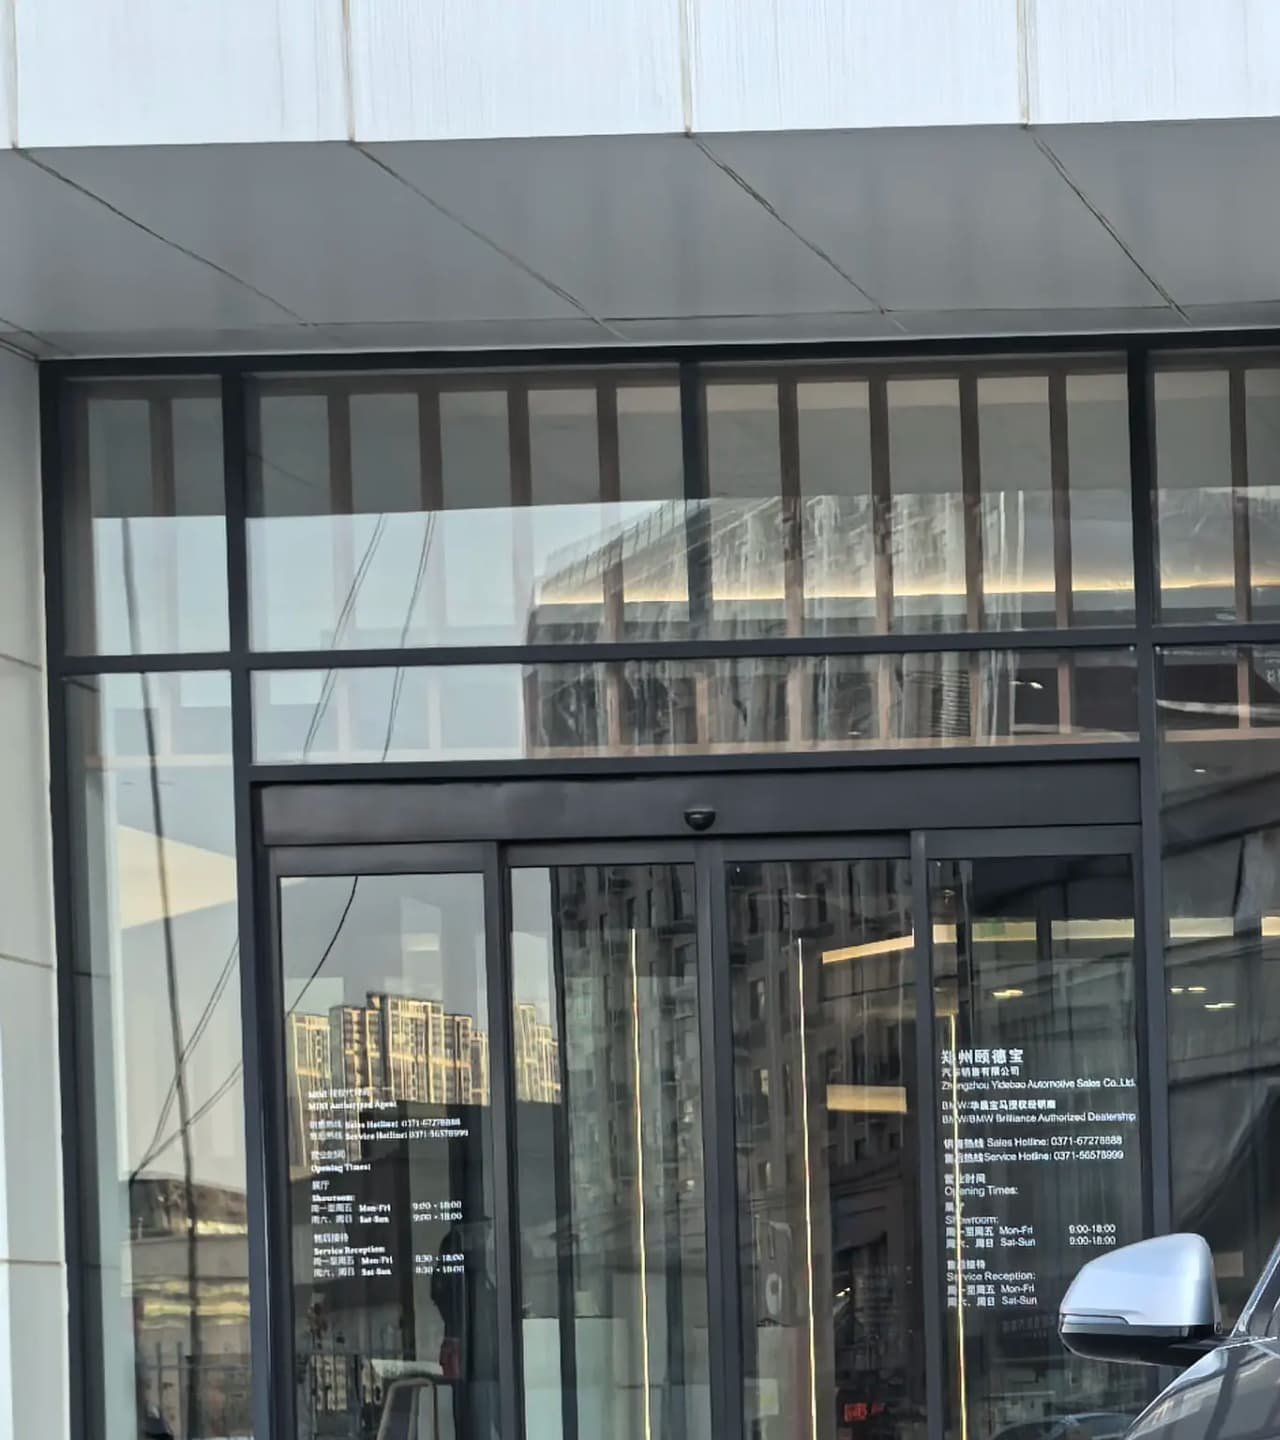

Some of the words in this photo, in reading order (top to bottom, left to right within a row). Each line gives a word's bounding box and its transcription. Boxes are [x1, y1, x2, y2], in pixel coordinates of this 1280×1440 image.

[941, 1080, 990, 1092] Zhngzhou
[1027, 1079, 1075, 1089] Automotive
[1076, 1078, 1101, 1088] Sales
[1038, 1113, 1086, 1122] Authorized
[986, 1138, 1013, 1148] Sales
[945, 1215, 999, 1225] Shwroom:
[999, 1225, 1033, 1235] Mon-Fri
[1000, 1237, 1036, 1247] Sat-Sun
[946, 1272, 982, 1282] Sevice
[1000, 1283, 1034, 1294] Mon-Fri
[1002, 1295, 1038, 1306] Sat-Sun
